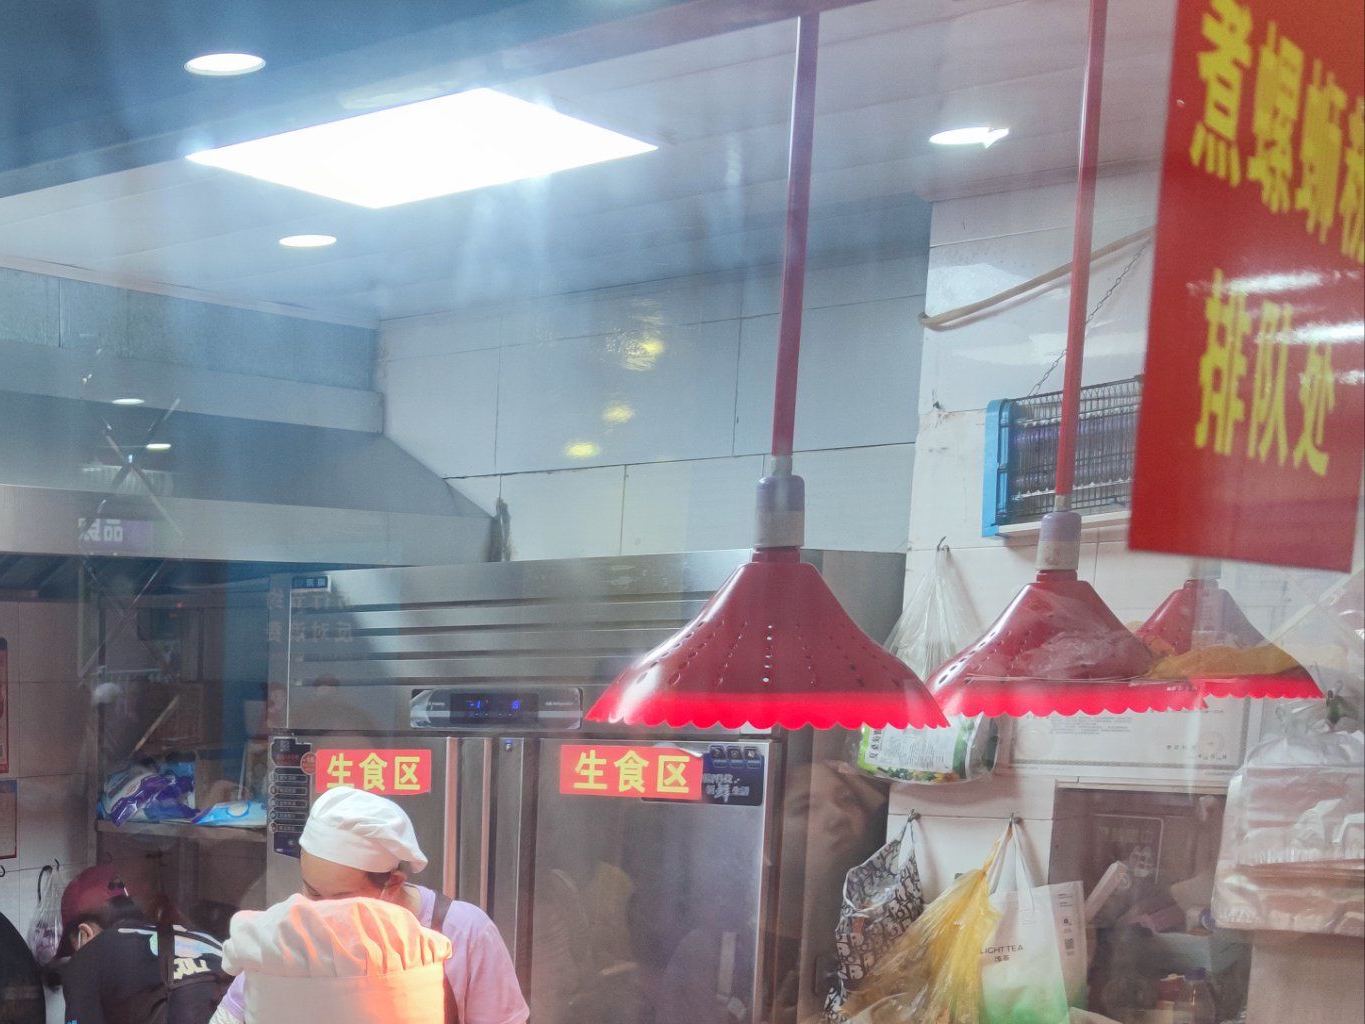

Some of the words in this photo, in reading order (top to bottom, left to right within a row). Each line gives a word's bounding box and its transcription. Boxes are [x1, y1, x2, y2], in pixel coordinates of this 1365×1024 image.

[1195, 268, 1335, 477] 排队处
[326, 752, 421, 791] 生食区
[572, 749, 691, 794] 生食区
